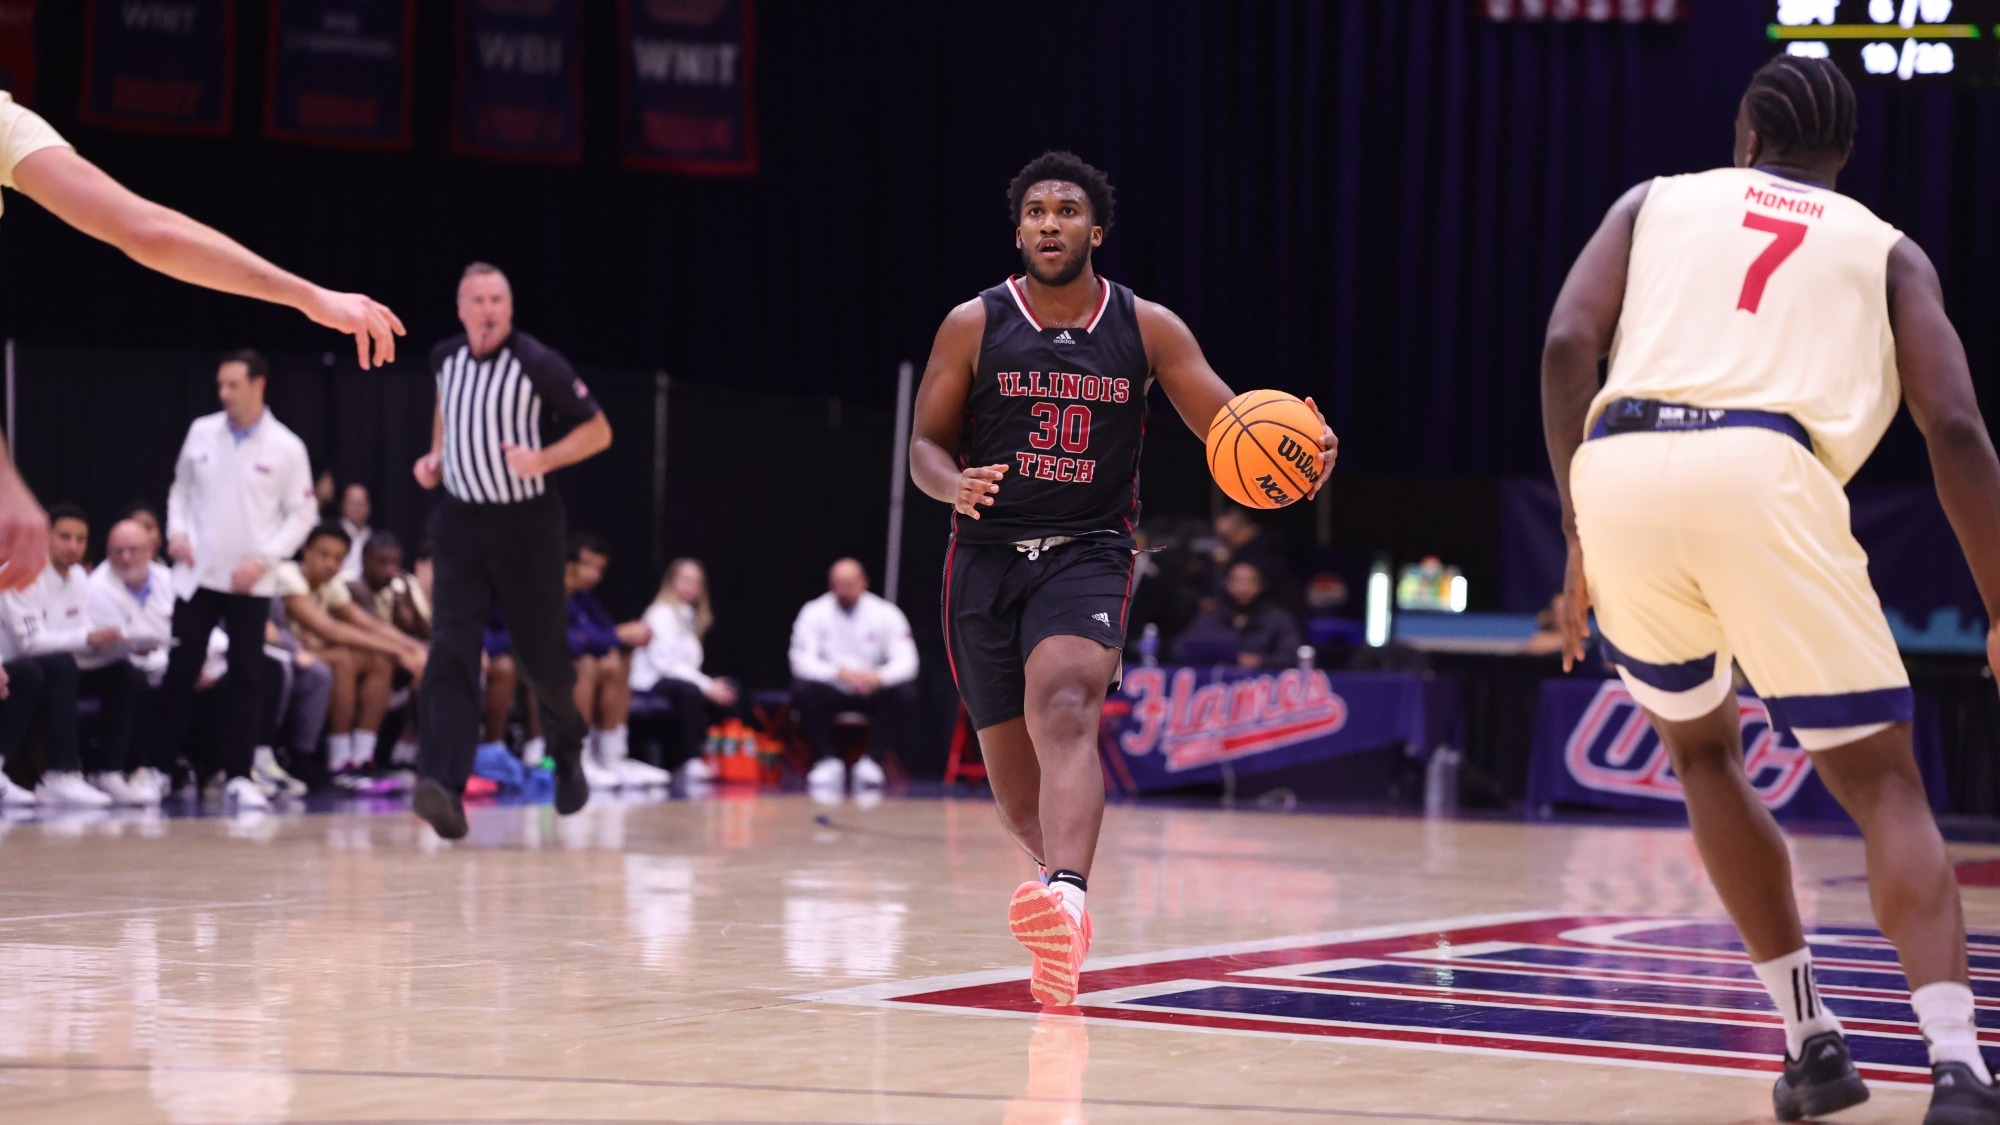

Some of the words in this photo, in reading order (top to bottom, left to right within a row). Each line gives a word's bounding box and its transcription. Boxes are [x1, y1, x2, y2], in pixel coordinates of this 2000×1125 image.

[1745, 186, 1824, 219] MOMOH
[1736, 211, 1808, 315] 7
[1053, 338, 1076, 346] adidas
[997, 371, 1130, 403] ILLINOIS
[1029, 401, 1092, 453] 30
[1016, 451, 1096, 483] TECH
[1277, 434, 1320, 484] Wilso
